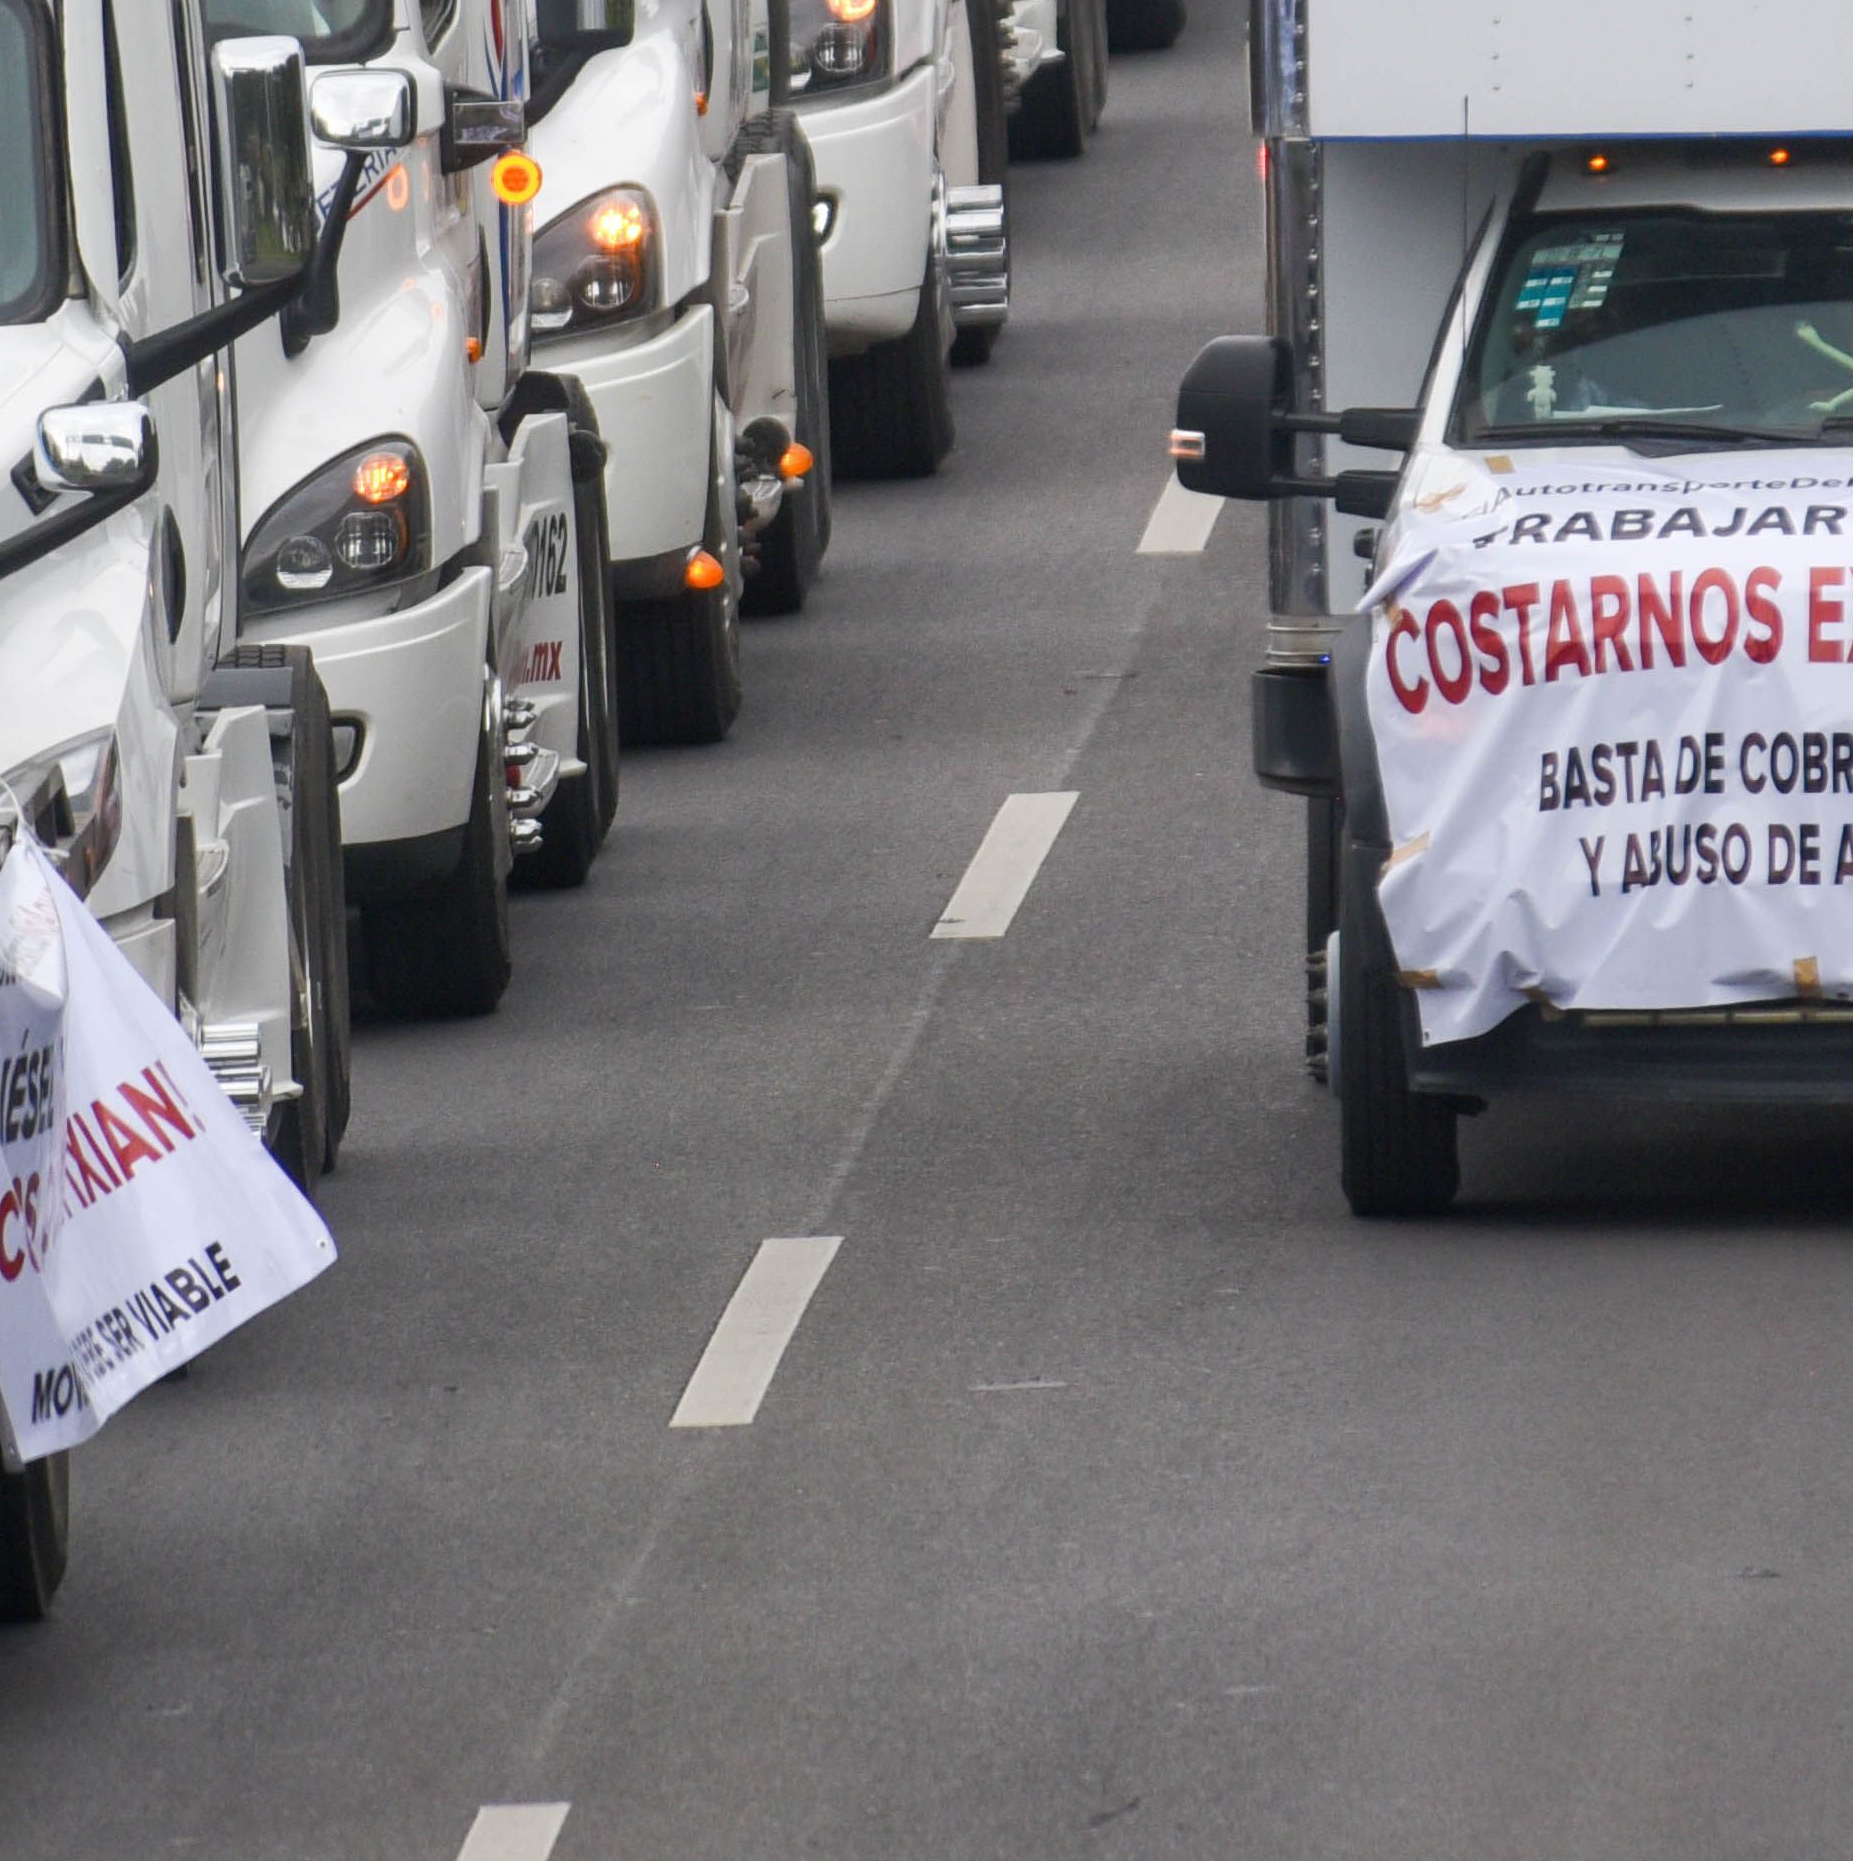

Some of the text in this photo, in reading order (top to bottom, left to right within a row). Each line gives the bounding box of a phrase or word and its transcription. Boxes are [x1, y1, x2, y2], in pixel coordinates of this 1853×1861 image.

[1386, 566, 1784, 714] COSTARNOS
[1538, 739, 1665, 812] BASTA
[1674, 732, 1725, 795] DE
[1579, 835, 1606, 897] Y
[1622, 822, 1752, 895] ABUSO
[1767, 823, 1820, 885] DE
[126, 1241, 242, 1341] VIABLE
